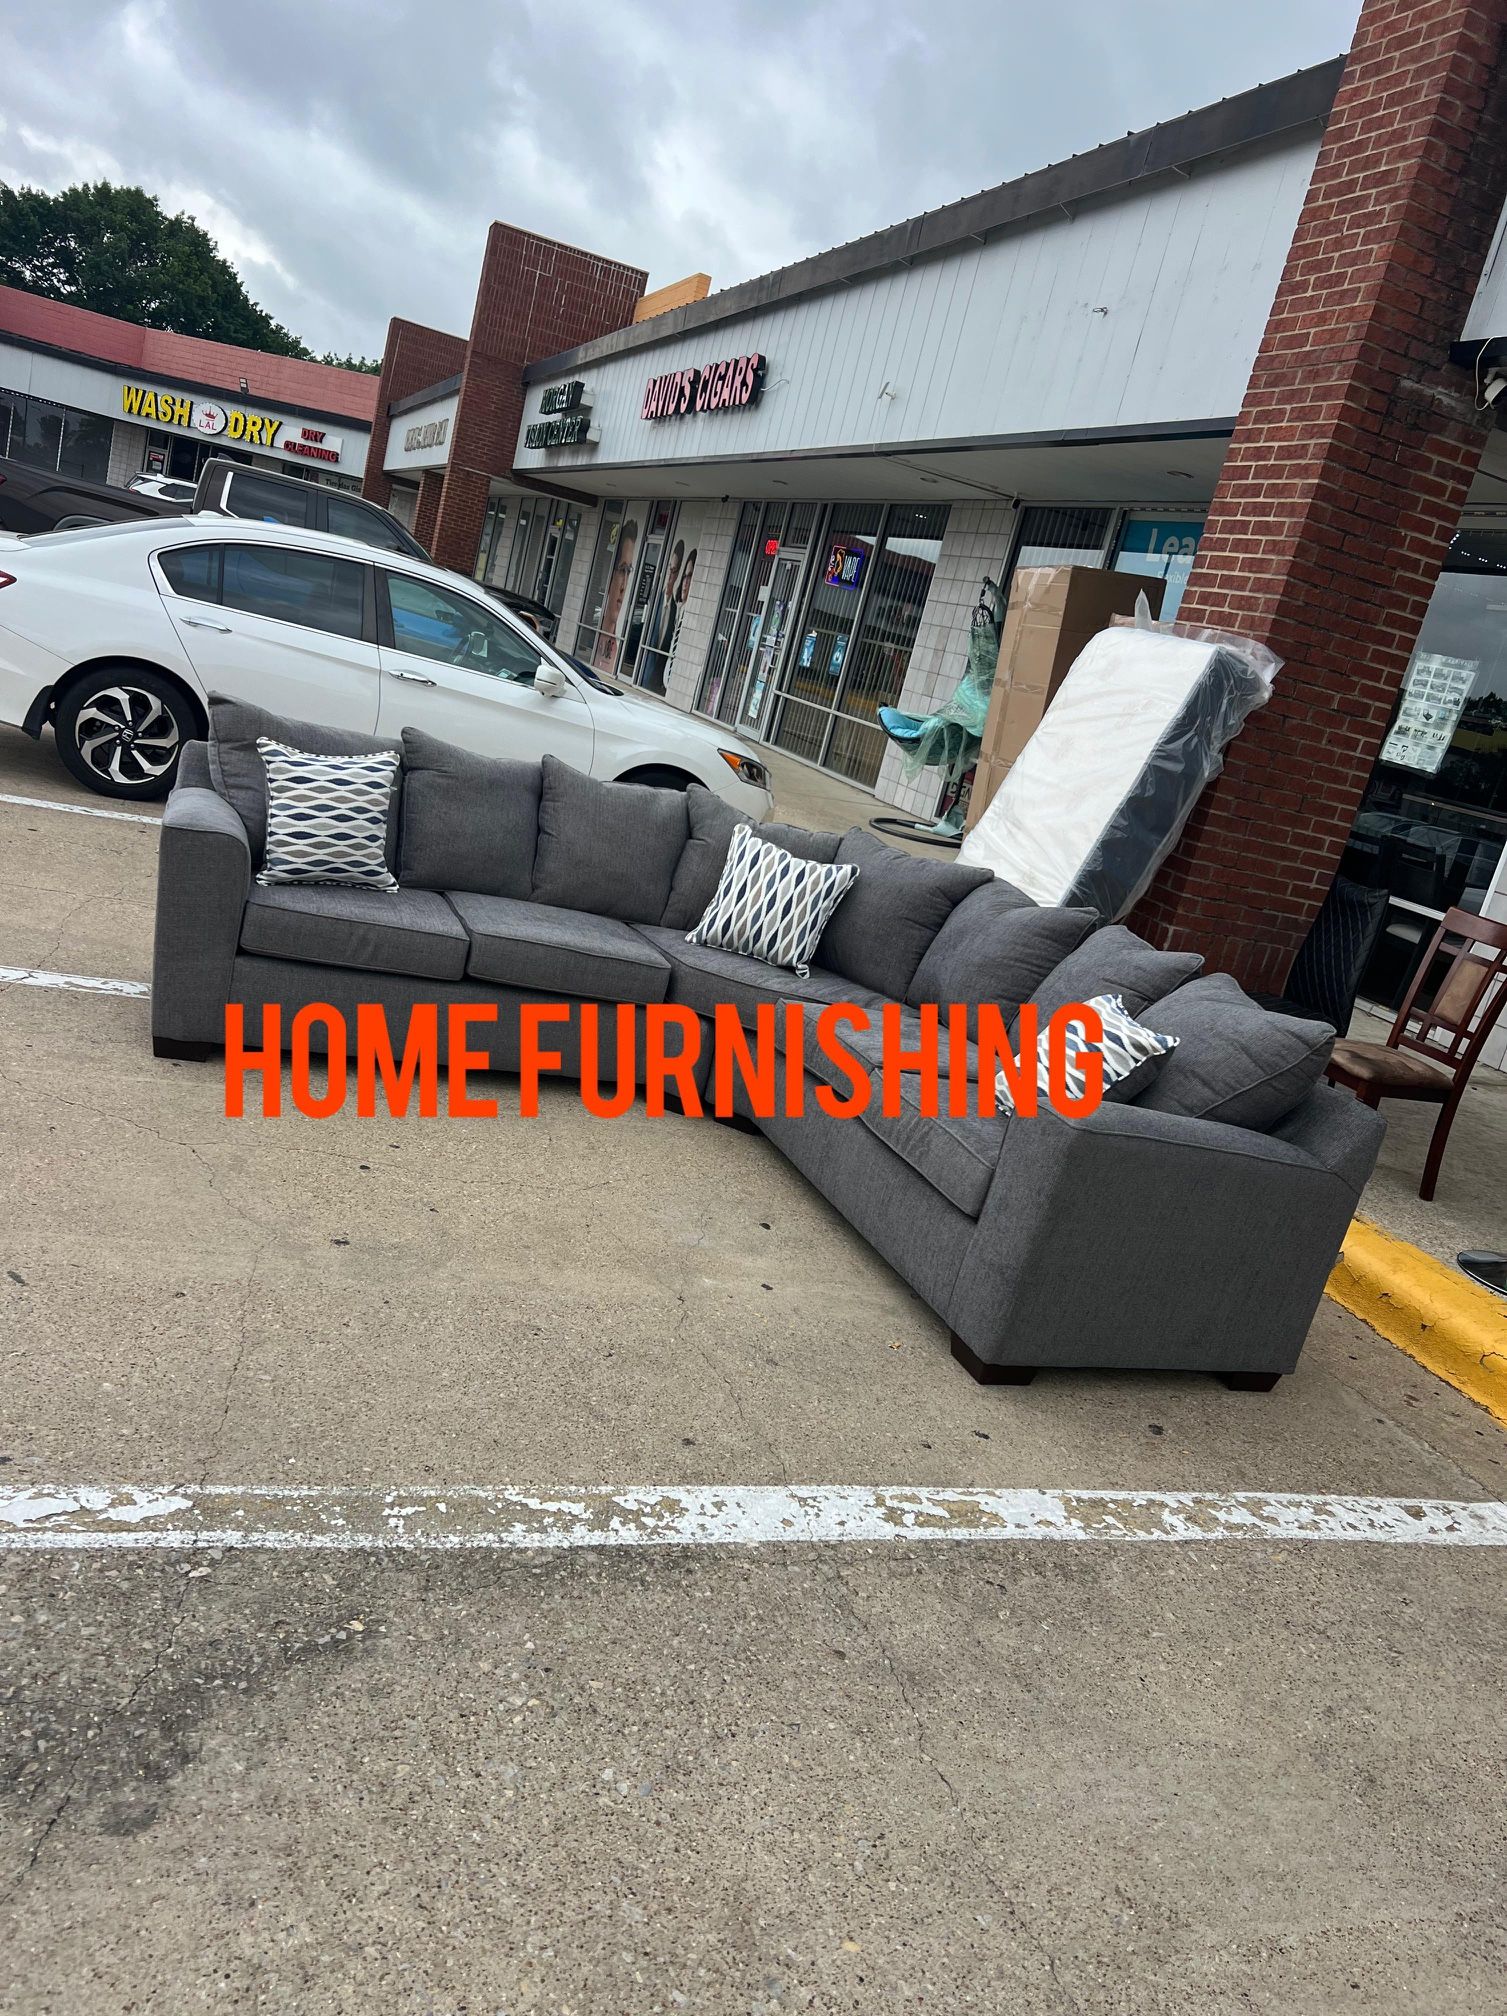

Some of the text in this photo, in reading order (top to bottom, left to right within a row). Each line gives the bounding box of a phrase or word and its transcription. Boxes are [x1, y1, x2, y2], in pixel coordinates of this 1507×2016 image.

[641, 352, 759, 419] DAVID'S CIGARS
[122, 384, 280, 447] WASH DRY
[198, 419, 217, 431] LAL
[301, 427, 324, 443] DRY
[283, 440, 338, 462] CLEANING
[1145, 528, 1197, 564] Lea
